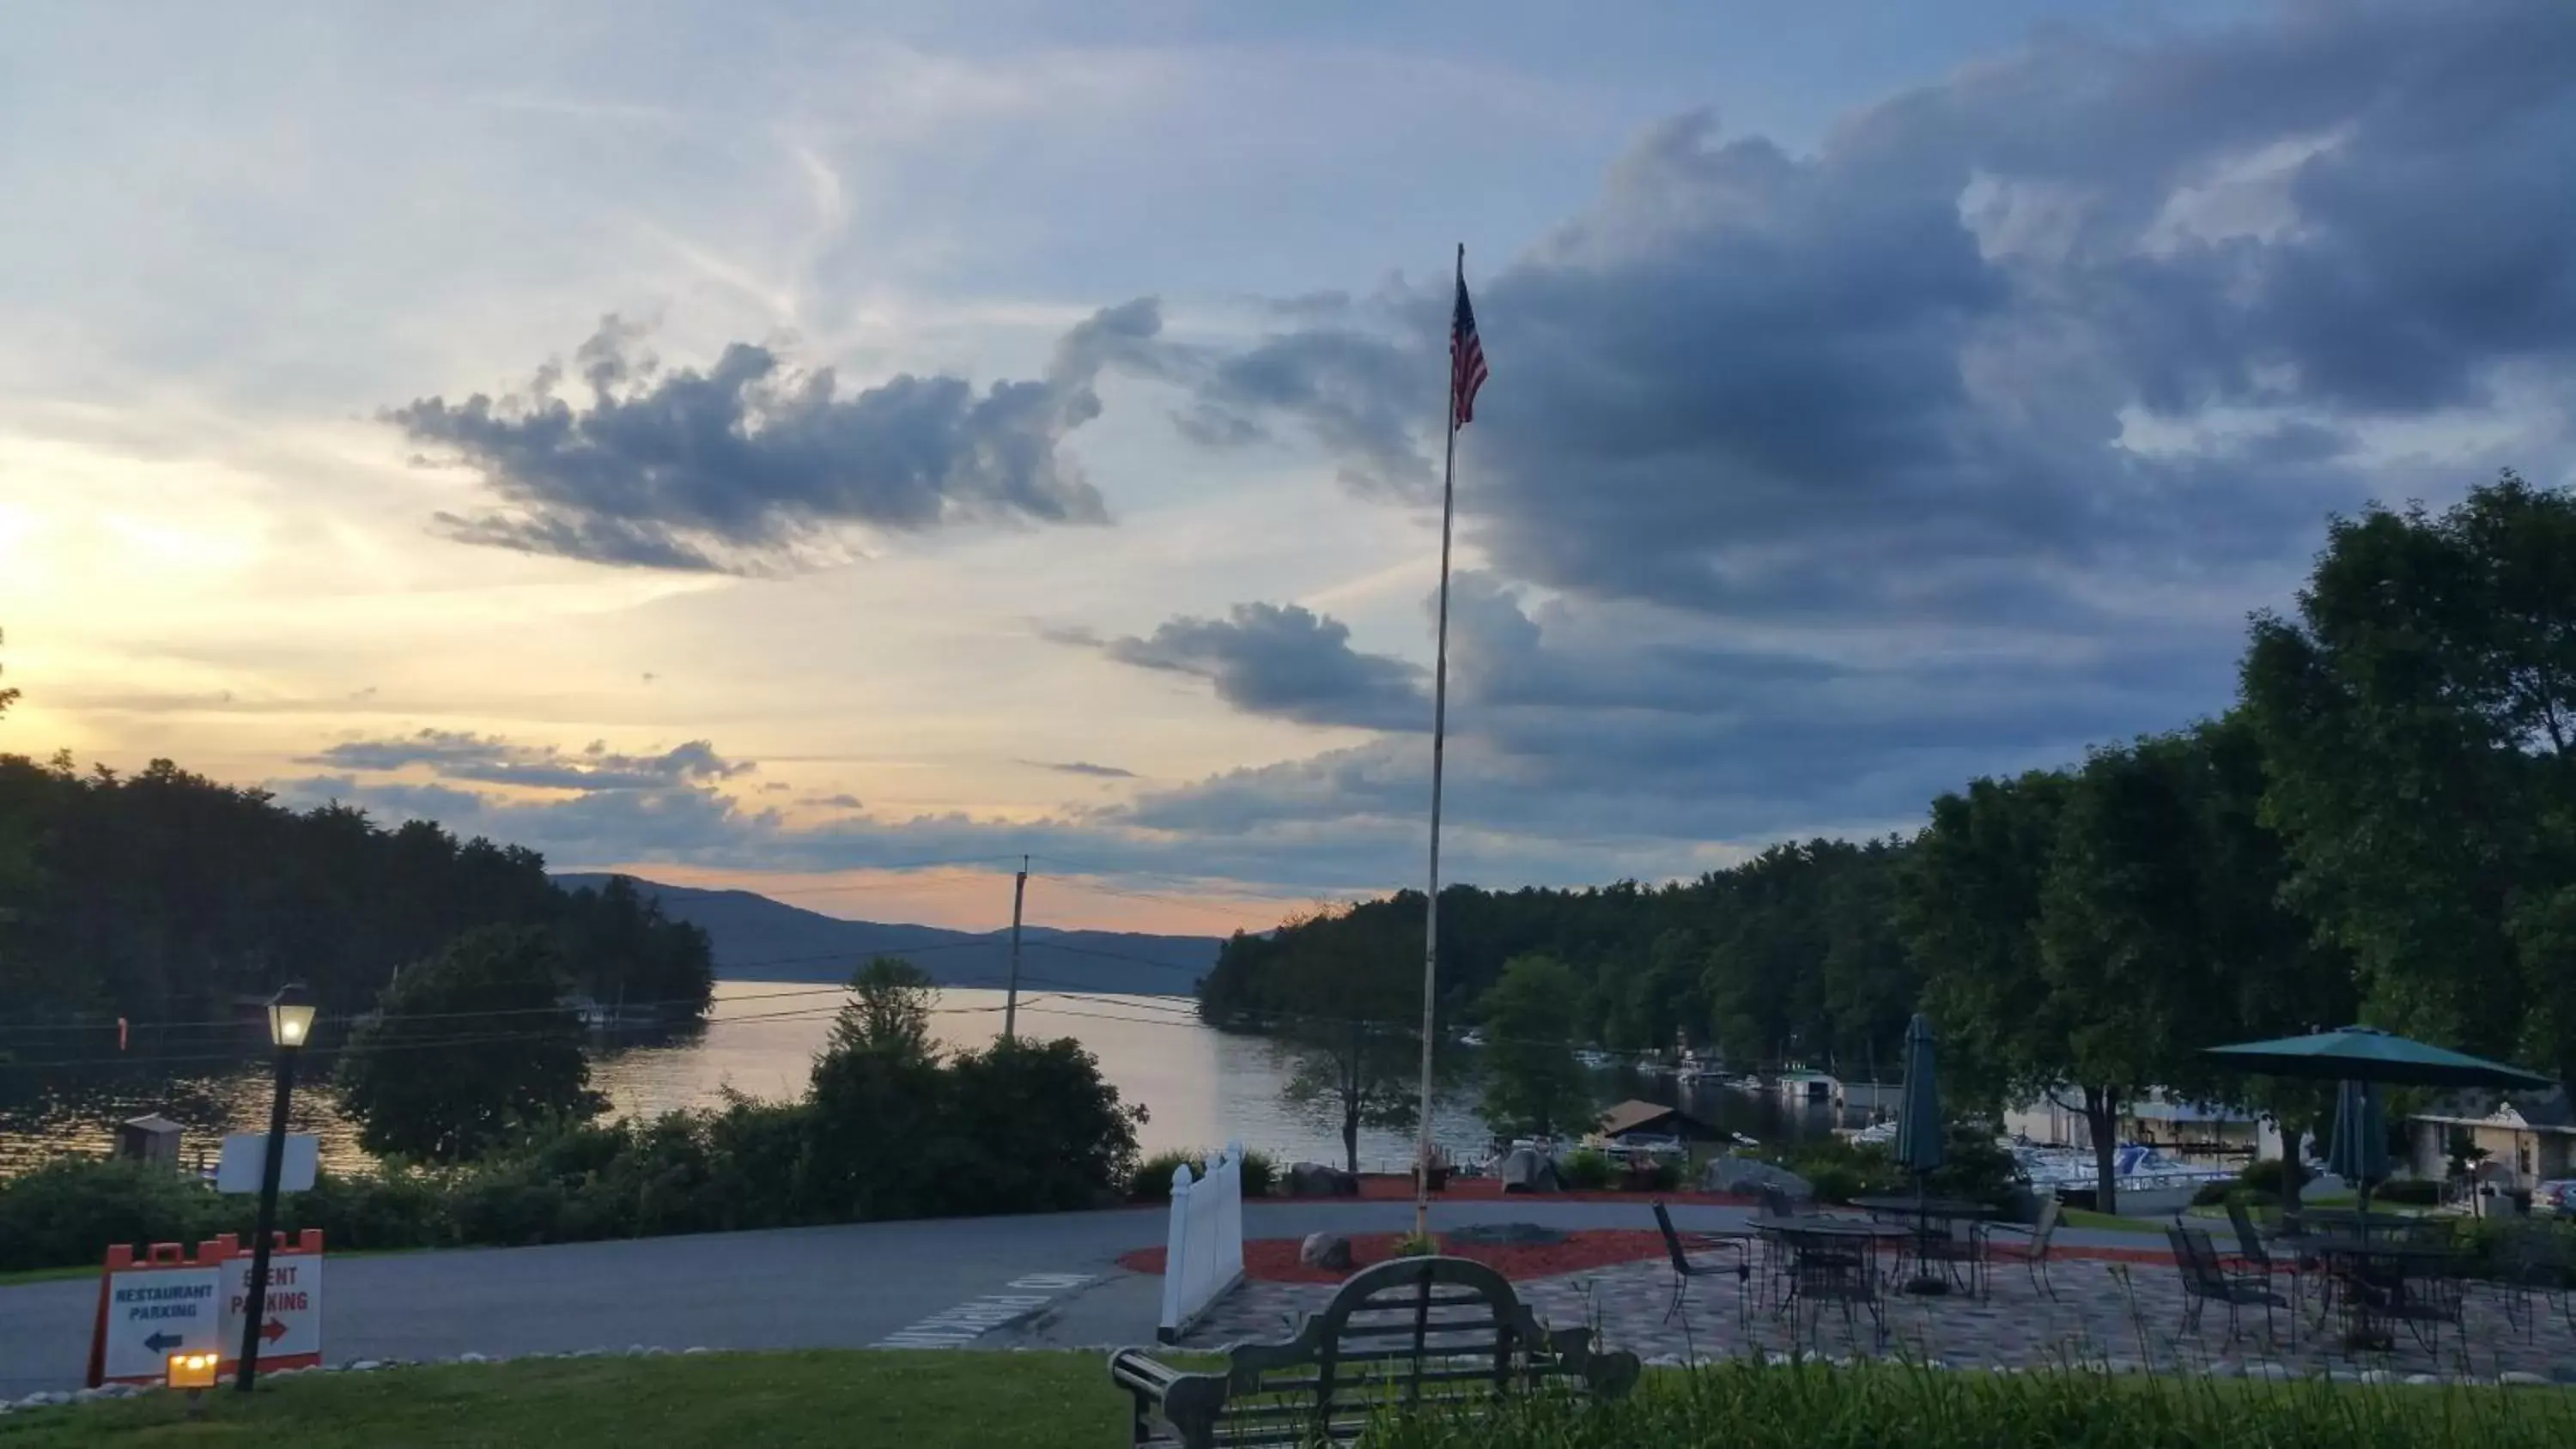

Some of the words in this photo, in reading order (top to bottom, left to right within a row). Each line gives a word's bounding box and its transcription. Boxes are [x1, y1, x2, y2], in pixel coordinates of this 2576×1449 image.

[243, 1266, 297, 1288] EENT
[116, 1284, 214, 1303] RESTAURANT
[231, 1291, 307, 1316] PKING
[129, 1304, 197, 1321] PARKING
[866, 1295, 1052, 1349] PARKIN
